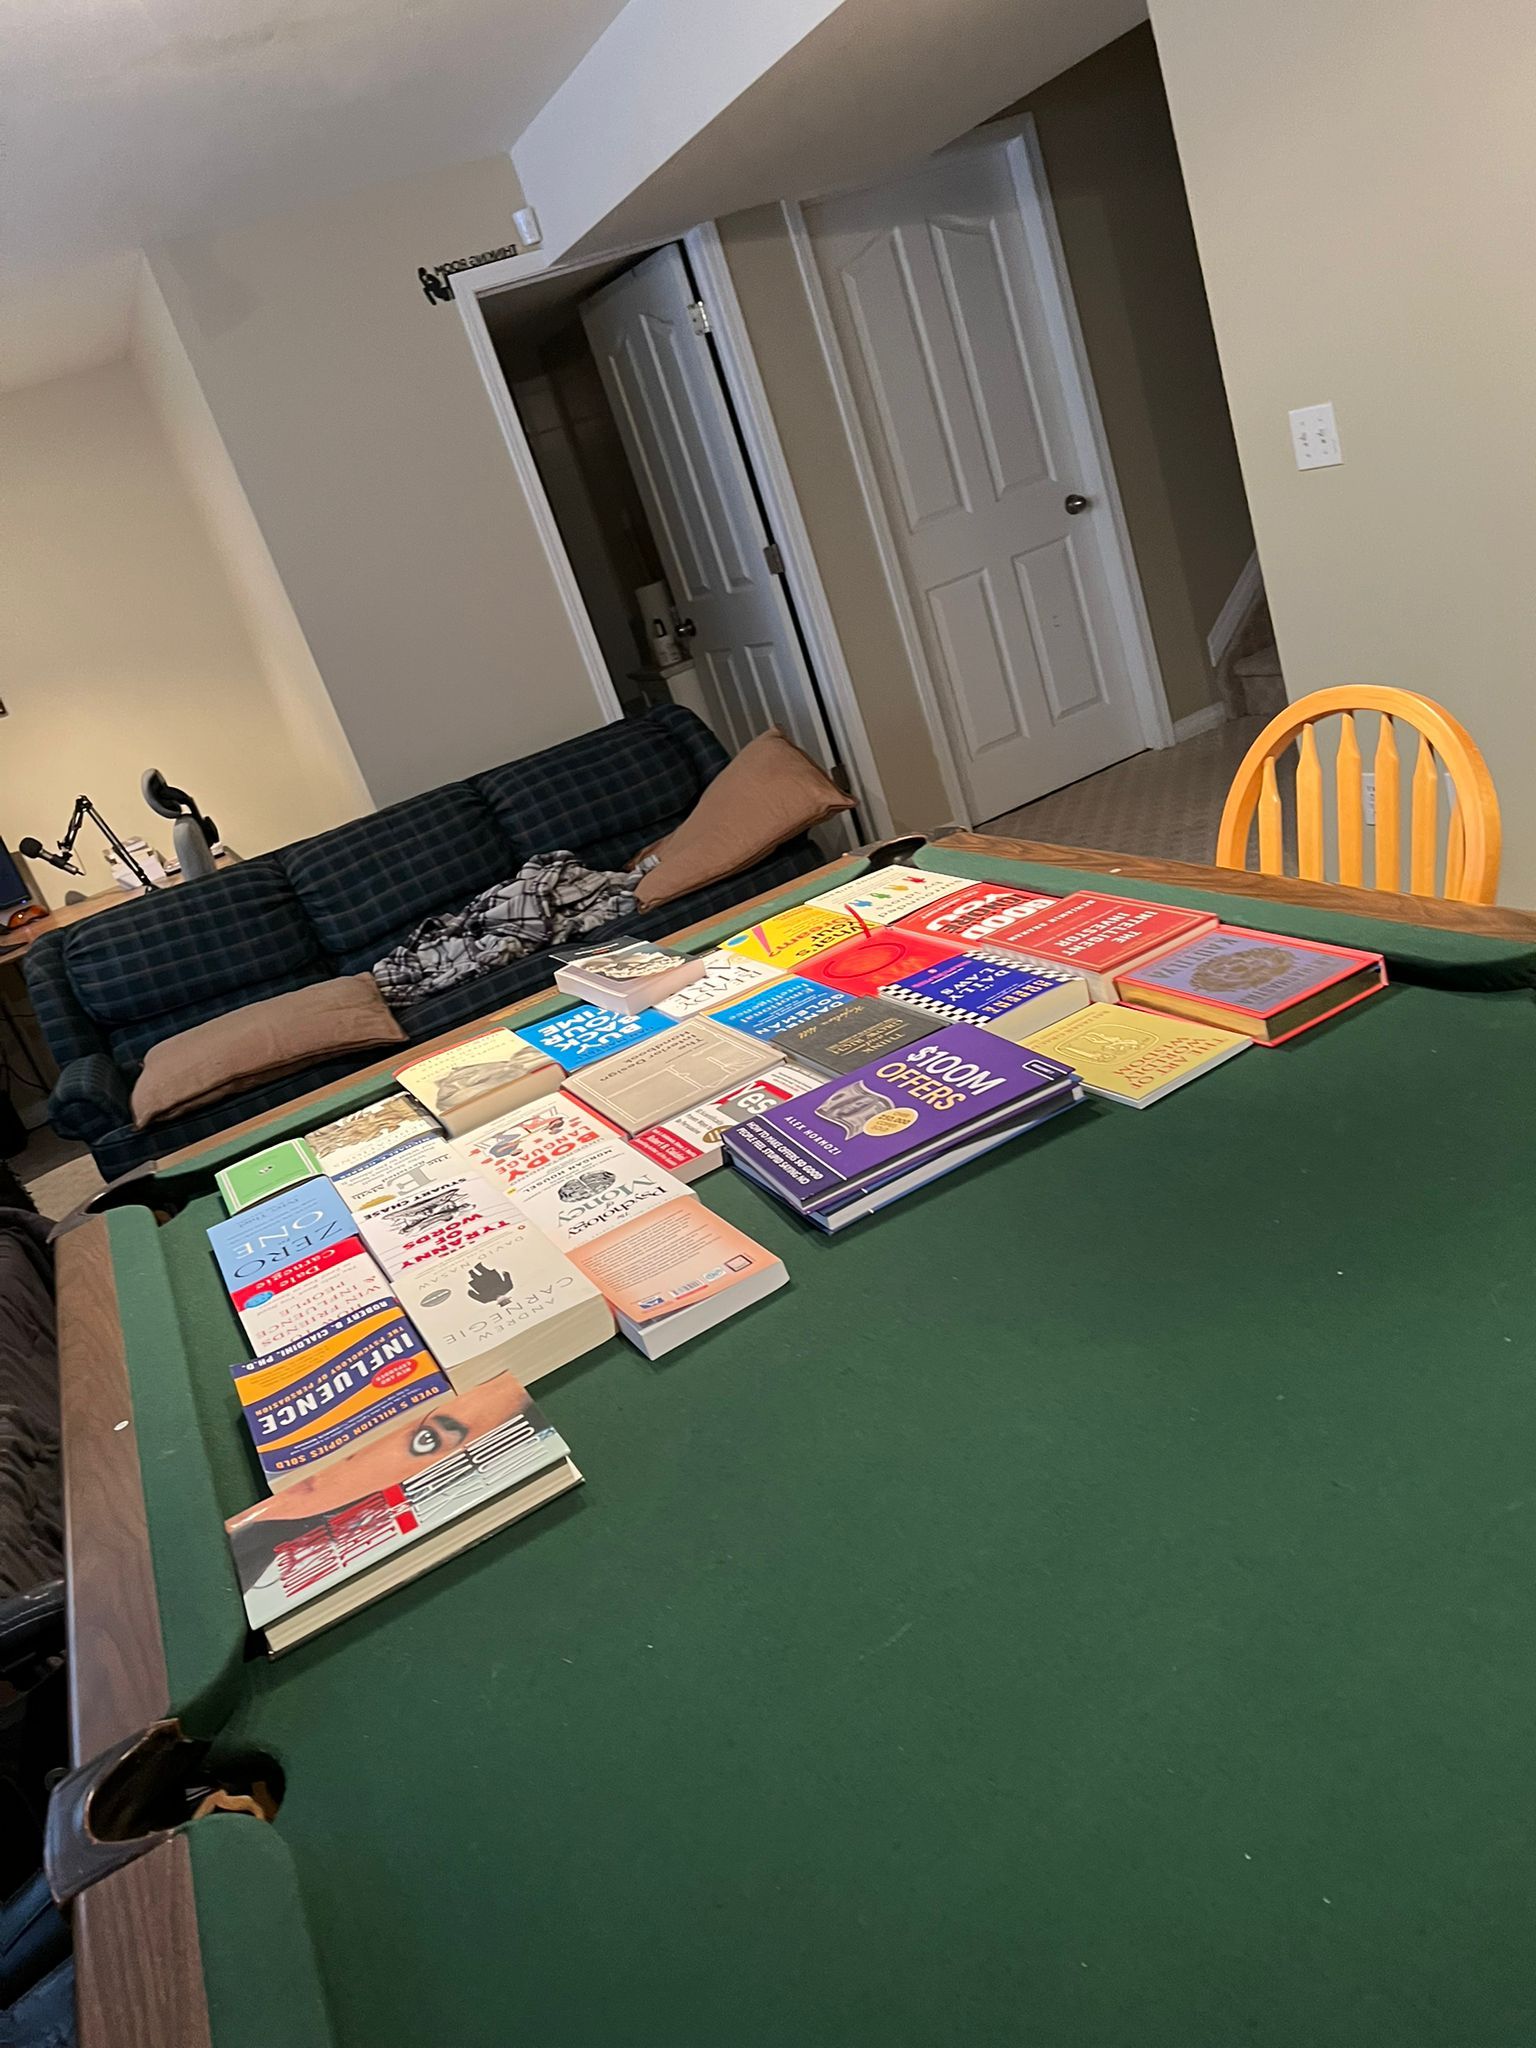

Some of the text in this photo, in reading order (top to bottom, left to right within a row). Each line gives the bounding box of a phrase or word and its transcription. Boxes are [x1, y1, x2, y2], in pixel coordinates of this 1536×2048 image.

[926, 892, 1016, 931] YOU
[961, 898, 1058, 940] GOOD
[1053, 912, 1130, 948] INVESTOR
[1061, 910, 1158, 956] INTELLIGENT
[1110, 931, 1143, 945] THE
[940, 967, 997, 996] LAWS
[949, 970, 1010, 1002] DAILY
[755, 993, 845, 1035] GOLEMAN
[553, 1015, 641, 1053] BACK
[576, 1023, 643, 1054] BUY
[624, 1030, 690, 1064] Handbook
[676, 1038, 704, 1050] The
[599, 1033, 697, 1082] Interior Design
[906, 1045, 1007, 1095] $100M
[1112, 1036, 1189, 1076] WISDOM
[727, 1081, 777, 1114] Yes
[875, 1062, 967, 1110] OFFERS
[495, 1125, 591, 1175] LANGUAGE
[746, 1121, 825, 1180] HOW TO MAKE OFFERS SO GOOD
[783, 1115, 842, 1156] ALEX HORMOZI
[508, 1131, 600, 1182] BODY
[568, 1149, 613, 1170] MORGAN
[736, 1127, 811, 1185] PEOPLE FEEL STUPID SAYING NO
[363, 1178, 467, 1220] STUART CHASE
[523, 1170, 565, 1193] HOUSEL
[558, 1174, 656, 1227] Money
[402, 1213, 483, 1250] WORDS
[568, 1186, 668, 1239] Psychology
[233, 1211, 324, 1259] ONE
[234, 1220, 342, 1278] ZERO
[401, 1220, 511, 1270] TYRANNY
[435, 1230, 462, 1245] OF
[477, 1235, 525, 1261] DAVID
[255, 1249, 336, 1289] Carnegie
[279, 1266, 320, 1287] Dale
[418, 1261, 471, 1291] NASAW
[256, 1285, 358, 1337] INFLUENCE
[279, 1281, 345, 1316] PEOPLE
[347, 1285, 381, 1305] WIN
[347, 1300, 389, 1325] ROBERT
[443, 1276, 574, 1345] CARNEGIE
[262, 1305, 338, 1347] FRIENDS
[330, 1320, 344, 1331] B.
[477, 1296, 556, 1342] ANDREW
[240, 1355, 276, 1371] PH.D.
[329, 1337, 386, 1375] PSYCHOLOGY
[257, 1333, 415, 1435] INFLUENCE
[316, 1372, 329, 1385] OF
[410, 1386, 440, 1404] OVER
[255, 1382, 315, 1417] PERSUASION
[353, 1407, 398, 1436] MILLION
[275, 1454, 306, 1470] SOLD
[309, 1434, 350, 1460] COPIES
